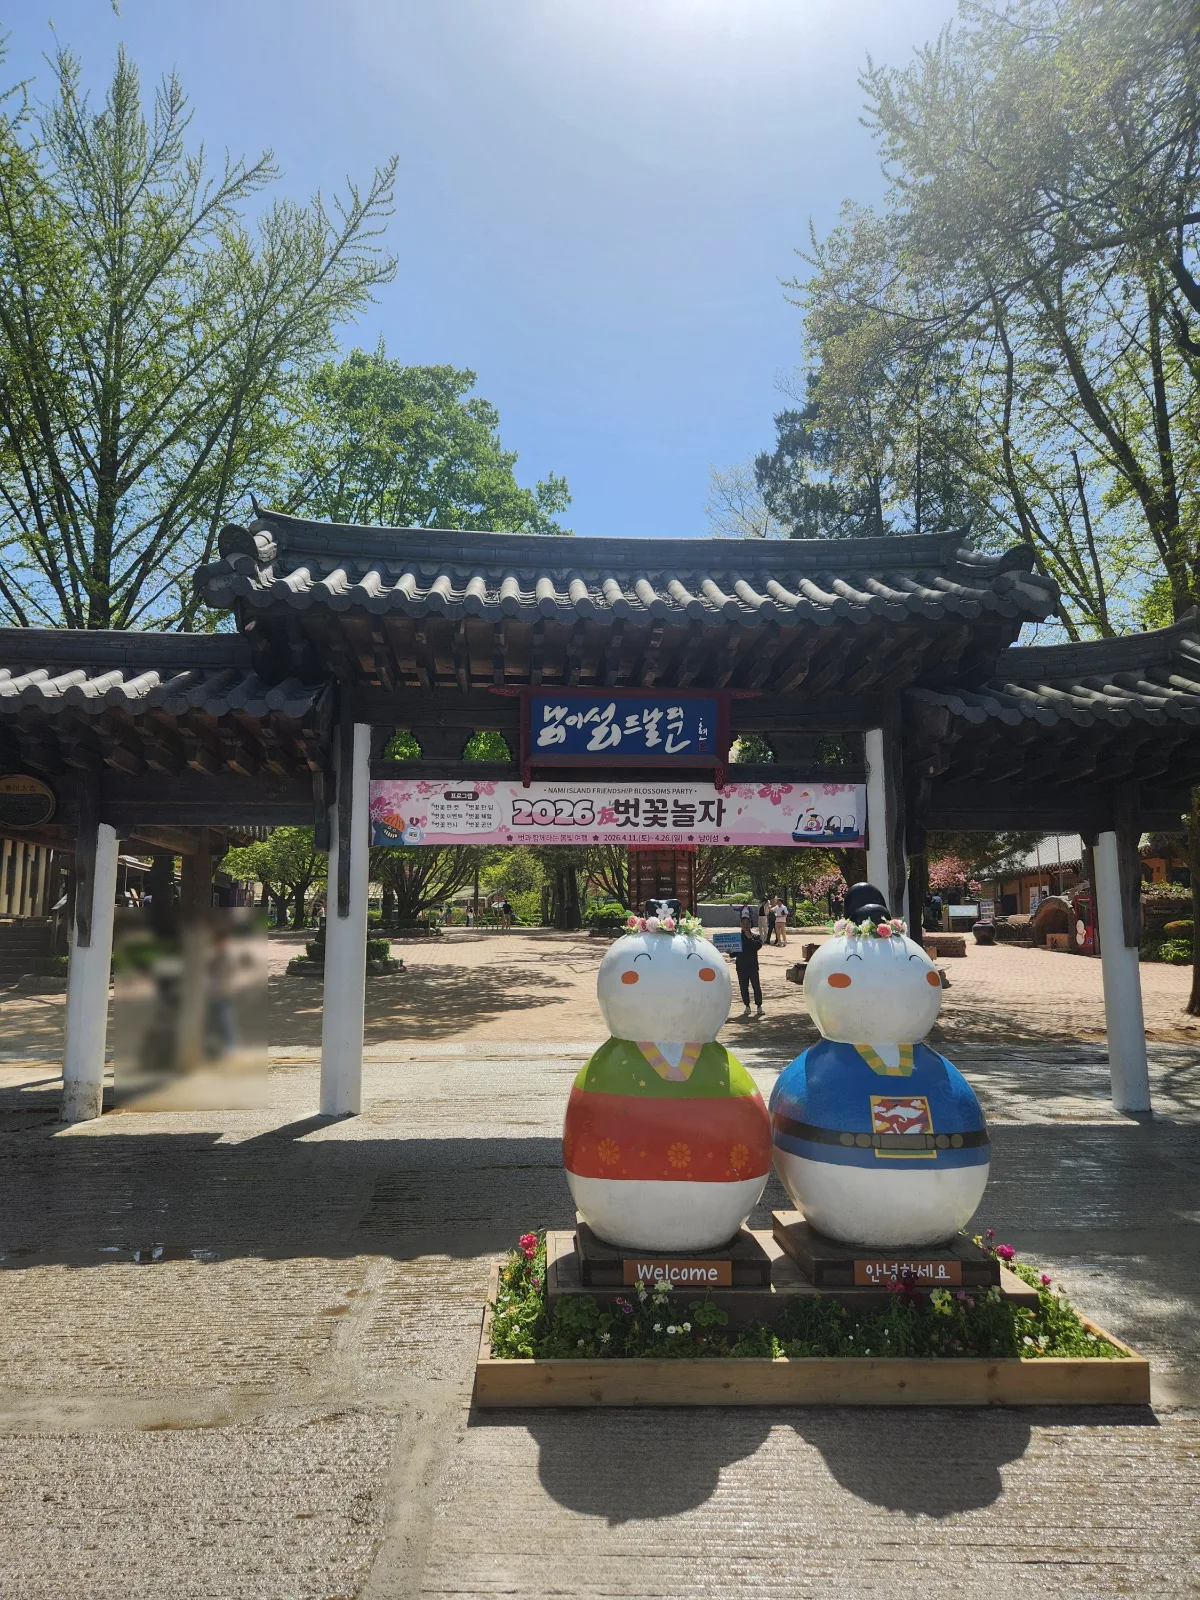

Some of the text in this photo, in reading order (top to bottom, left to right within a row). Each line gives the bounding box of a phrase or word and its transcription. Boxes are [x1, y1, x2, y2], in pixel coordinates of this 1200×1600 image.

[450, 792, 473, 800] 프로그램
[634, 787, 671, 795] BLOSSOMS
[512, 799, 595, 826] 2026
[698, 834, 719, 843] 남이섬
[637, 1263, 718, 1281] Welcome
[865, 1262, 951, 1283] 안녕하세요
